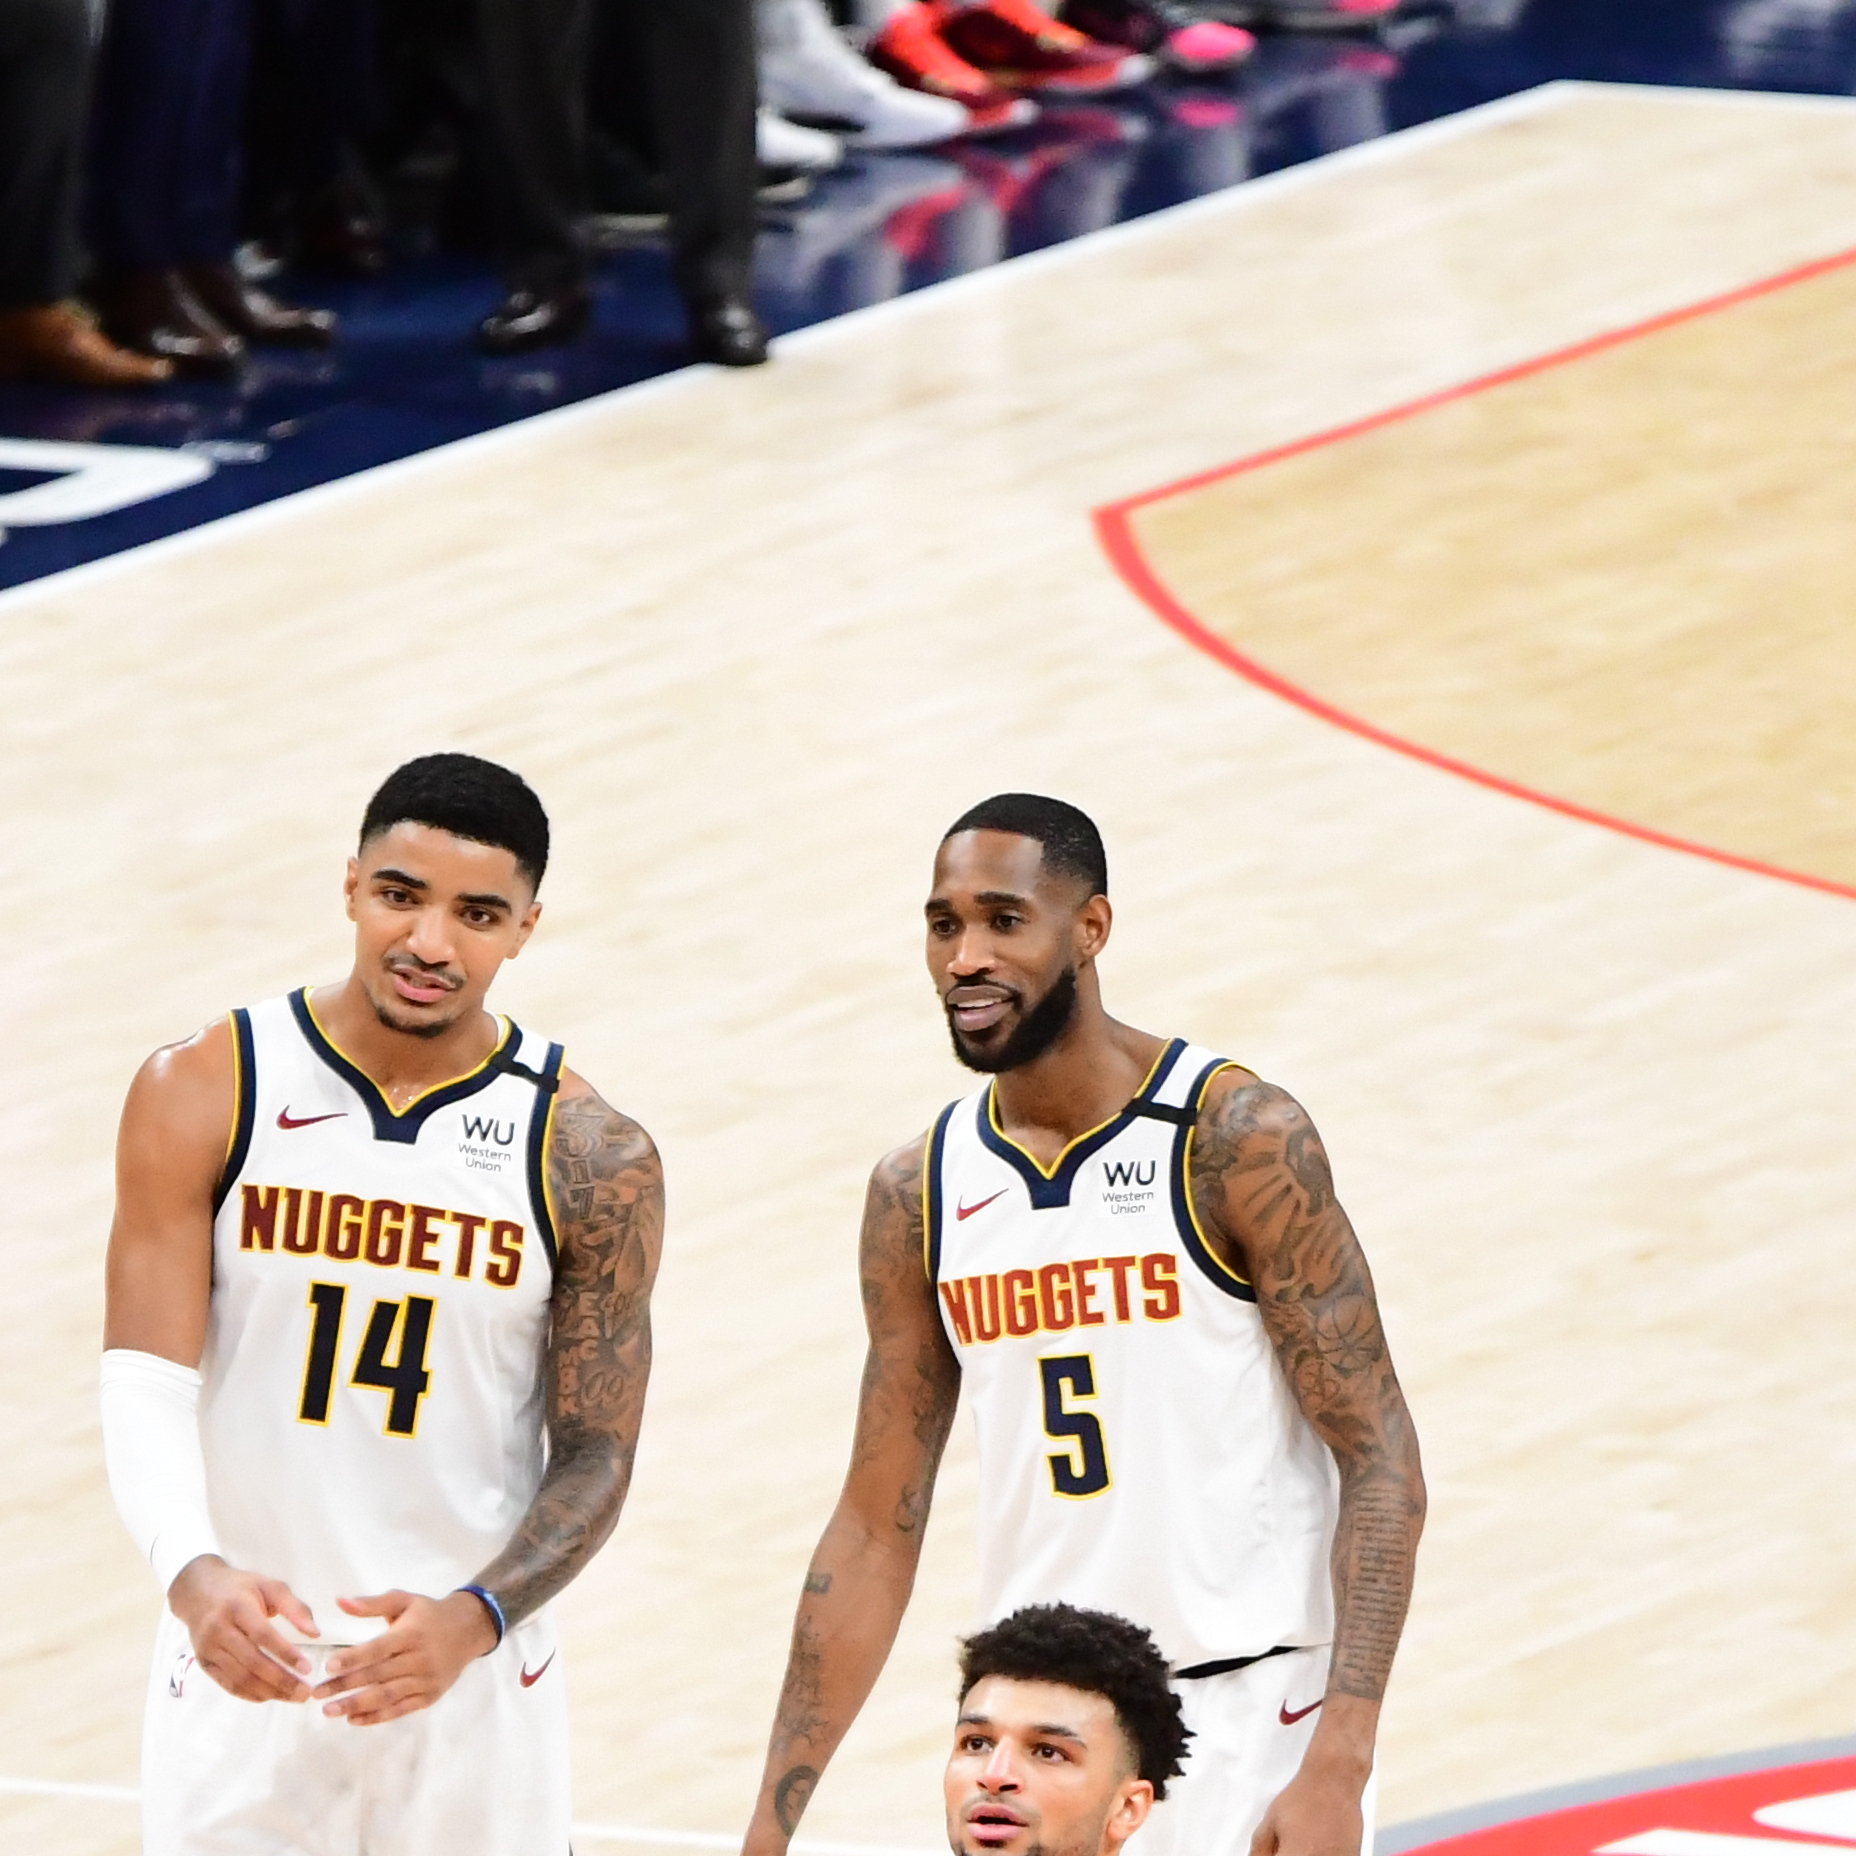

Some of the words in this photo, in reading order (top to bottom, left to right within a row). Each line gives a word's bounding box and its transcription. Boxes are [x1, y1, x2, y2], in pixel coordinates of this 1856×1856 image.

[462, 1113, 515, 1146] WU
[458, 1143, 512, 1162] Western
[465, 1157, 502, 1173] Union
[1102, 1160, 1156, 1187] WU
[1102, 1192, 1154, 1203] Western
[1111, 1202, 1145, 1215] Union
[239, 1183, 524, 1290] NUGGETS
[937, 1252, 1183, 1348] NUGGETS
[296, 1280, 438, 1440] 14
[1037, 1352, 1113, 1502] 5
